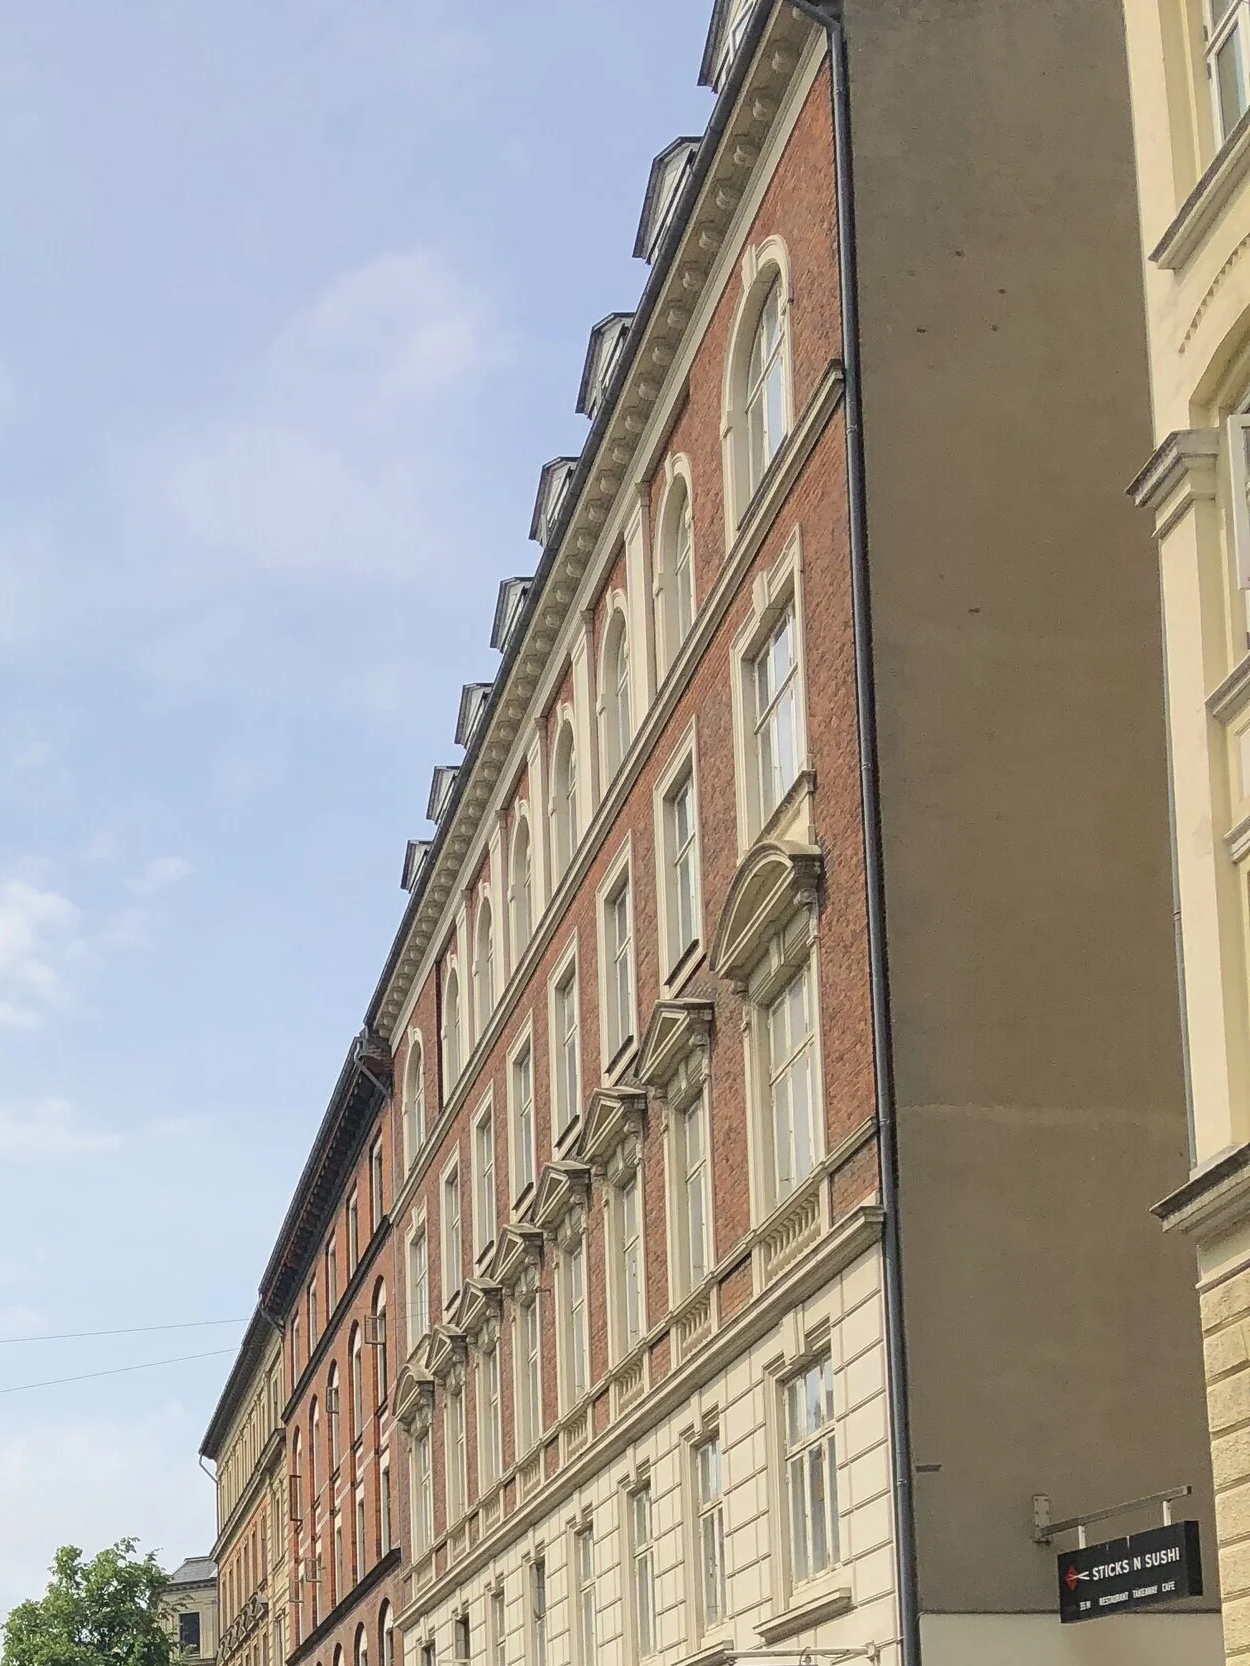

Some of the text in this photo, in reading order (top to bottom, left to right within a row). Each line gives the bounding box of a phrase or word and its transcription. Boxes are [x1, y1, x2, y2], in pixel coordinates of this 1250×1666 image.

[1093, 1547, 1180, 1581] STICKS N SUSHI
